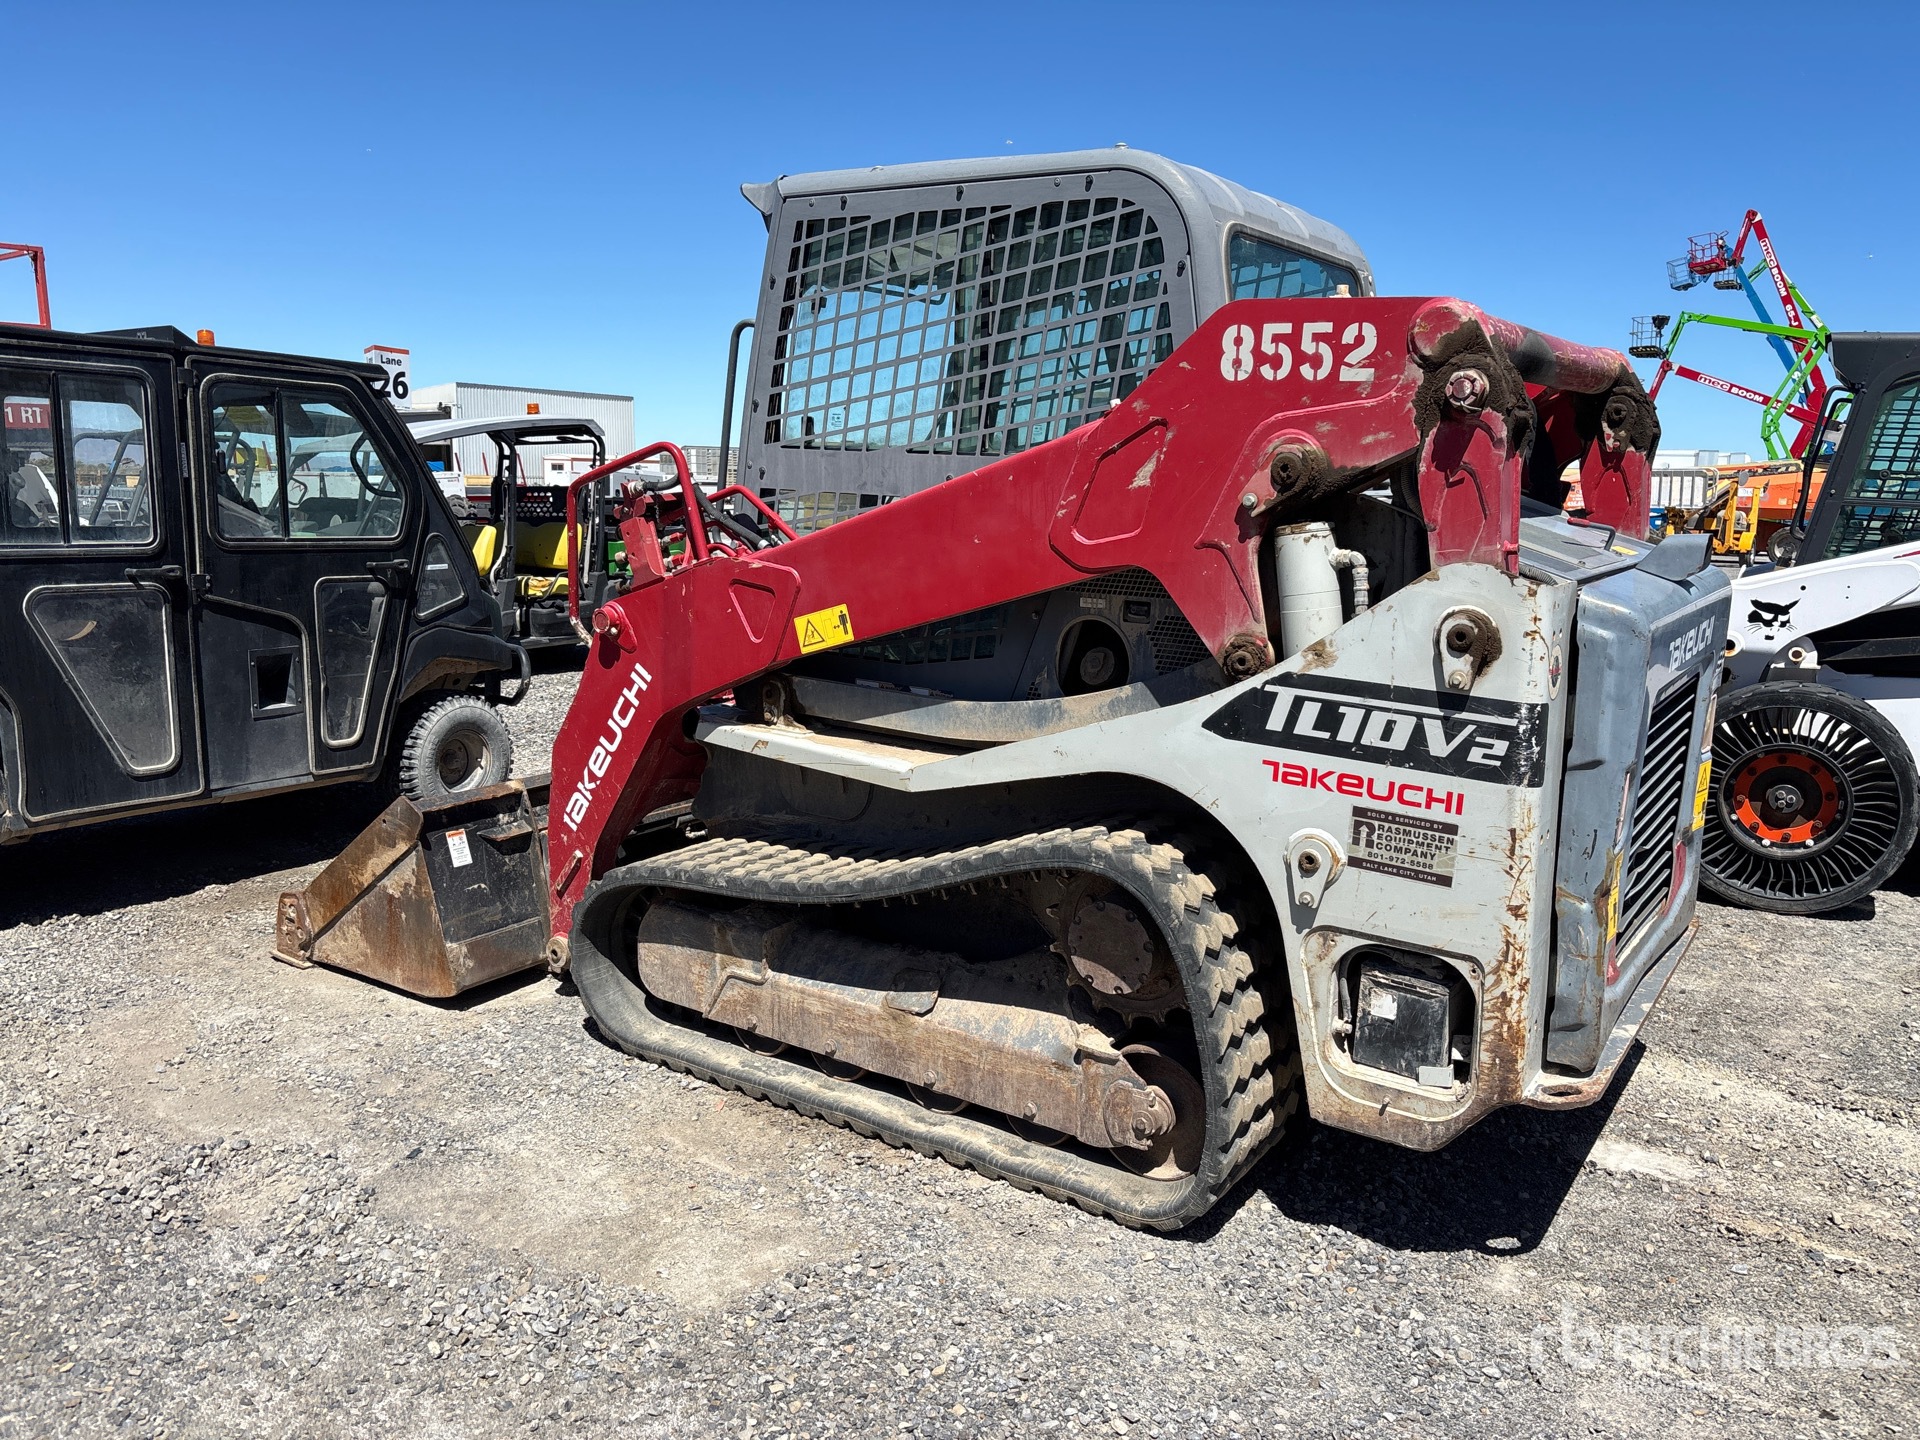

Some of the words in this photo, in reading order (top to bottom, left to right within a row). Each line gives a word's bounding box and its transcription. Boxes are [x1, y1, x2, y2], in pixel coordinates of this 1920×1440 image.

[1771, 267, 1787, 297] BOOM
[380, 354, 402, 366] Lane
[1220, 321, 1378, 382] 8552
[1730, 386, 1764, 403] BOOM
[20, 406, 43, 423] RT
[1264, 684, 1519, 767] TL10V2
[563, 662, 653, 832] TAKEUCHI
[1262, 759, 1465, 816] TAKEUCHI
[1367, 811, 1385, 819] SOLD
[1395, 816, 1431, 828] SERVICED
[1376, 833, 1451, 854] EQUIPMENT
[1377, 823, 1455, 846] RASMUSSEN
[1367, 851, 1434, 870] 801-972-5588
[1375, 841, 1437, 861] COMPANY
[1380, 865, 1397, 874] LAKE
[1399, 869, 1417, 878] CITY,
